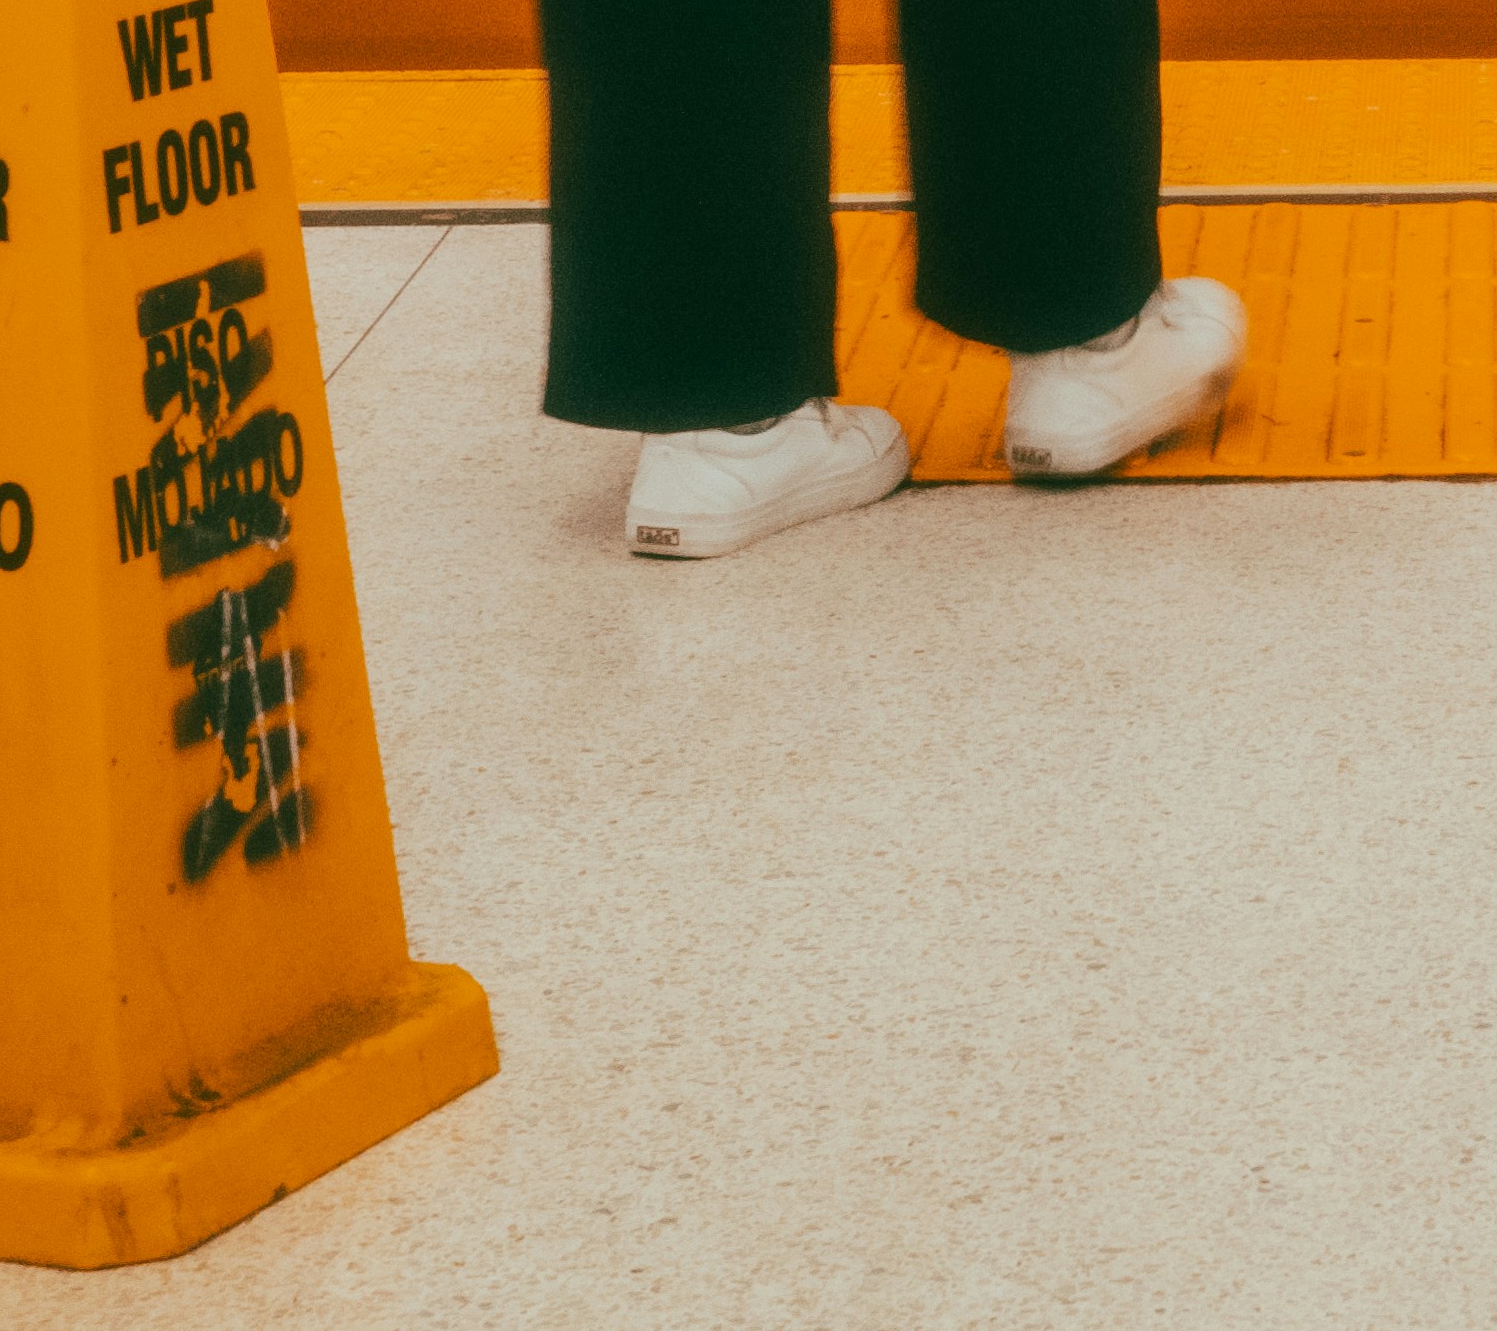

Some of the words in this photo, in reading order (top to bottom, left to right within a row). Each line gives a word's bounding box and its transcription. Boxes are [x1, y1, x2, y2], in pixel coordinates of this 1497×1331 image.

[103, 111, 256, 234] FLOOR
[145, 307, 251, 421] PISO
[112, 412, 304, 565] MOJADO
